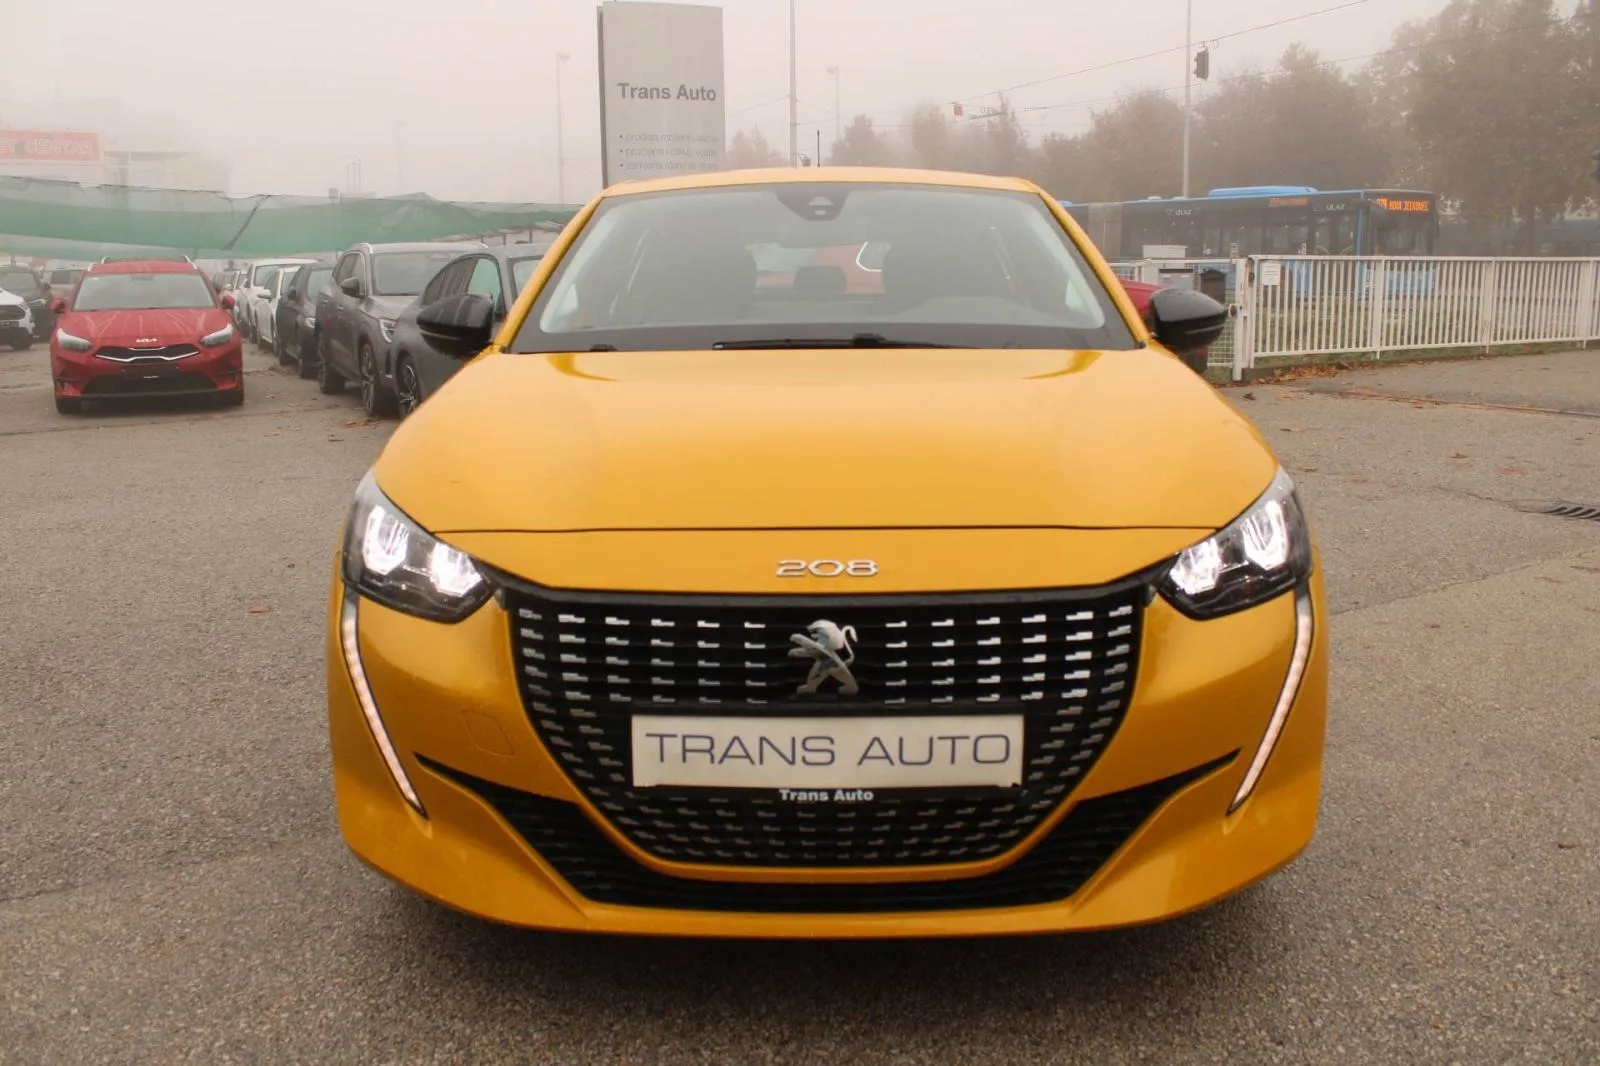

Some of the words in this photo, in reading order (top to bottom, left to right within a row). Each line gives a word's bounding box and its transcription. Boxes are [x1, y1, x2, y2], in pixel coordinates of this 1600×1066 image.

[617, 83, 671, 100] Trans
[676, 84, 717, 101] Auto
[776, 559, 878, 578] 208
[645, 733, 836, 767] TRANS
[857, 734, 1011, 767] AUTO
[779, 788, 830, 802] Trans
[833, 788, 875, 802] Auto
